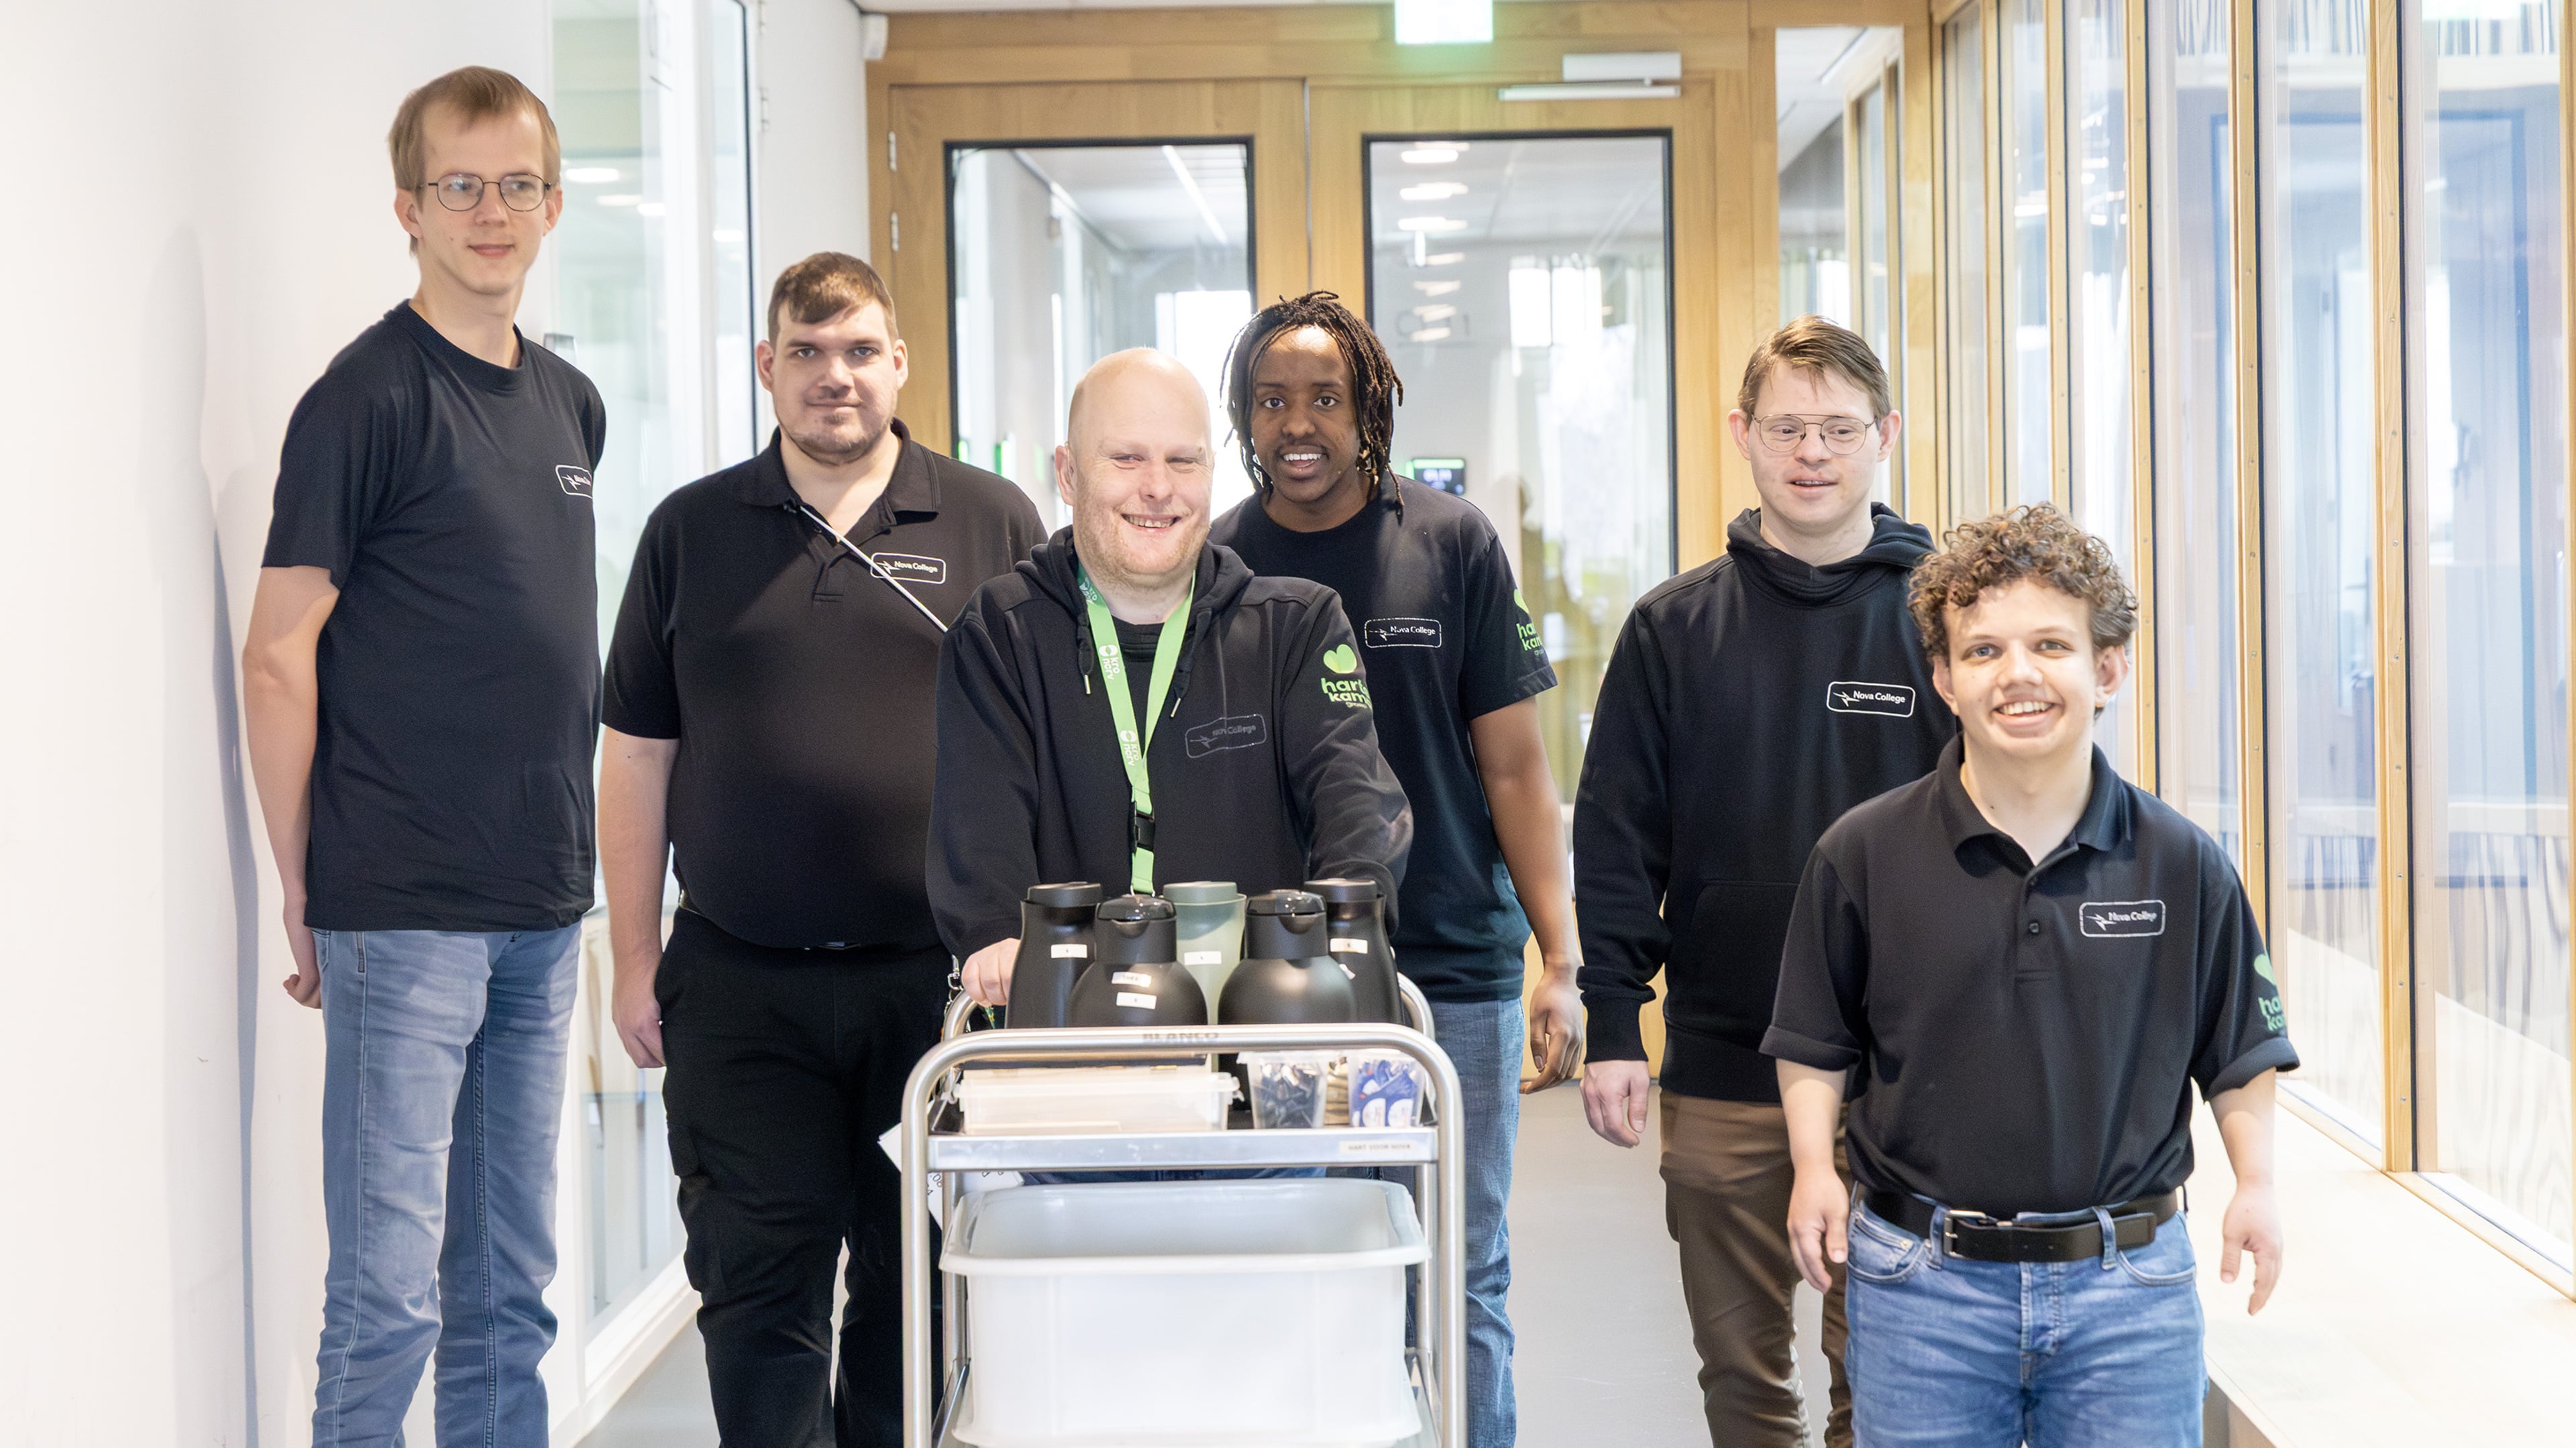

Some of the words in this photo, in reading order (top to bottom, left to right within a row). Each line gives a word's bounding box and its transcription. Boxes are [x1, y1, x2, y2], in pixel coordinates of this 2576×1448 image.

[894, 561, 912, 569] Nova
[912, 562, 938, 573] College
[1390, 625, 1409, 633] Nova
[1410, 626, 1436, 636] College
[1102, 658, 1115, 680] ncrv
[1110, 657, 1120, 674] kro
[1853, 690, 1874, 700] Nova
[1875, 692, 1906, 704] College
[1122, 744, 1135, 766] ncrv
[1130, 744, 1139, 761] kro
